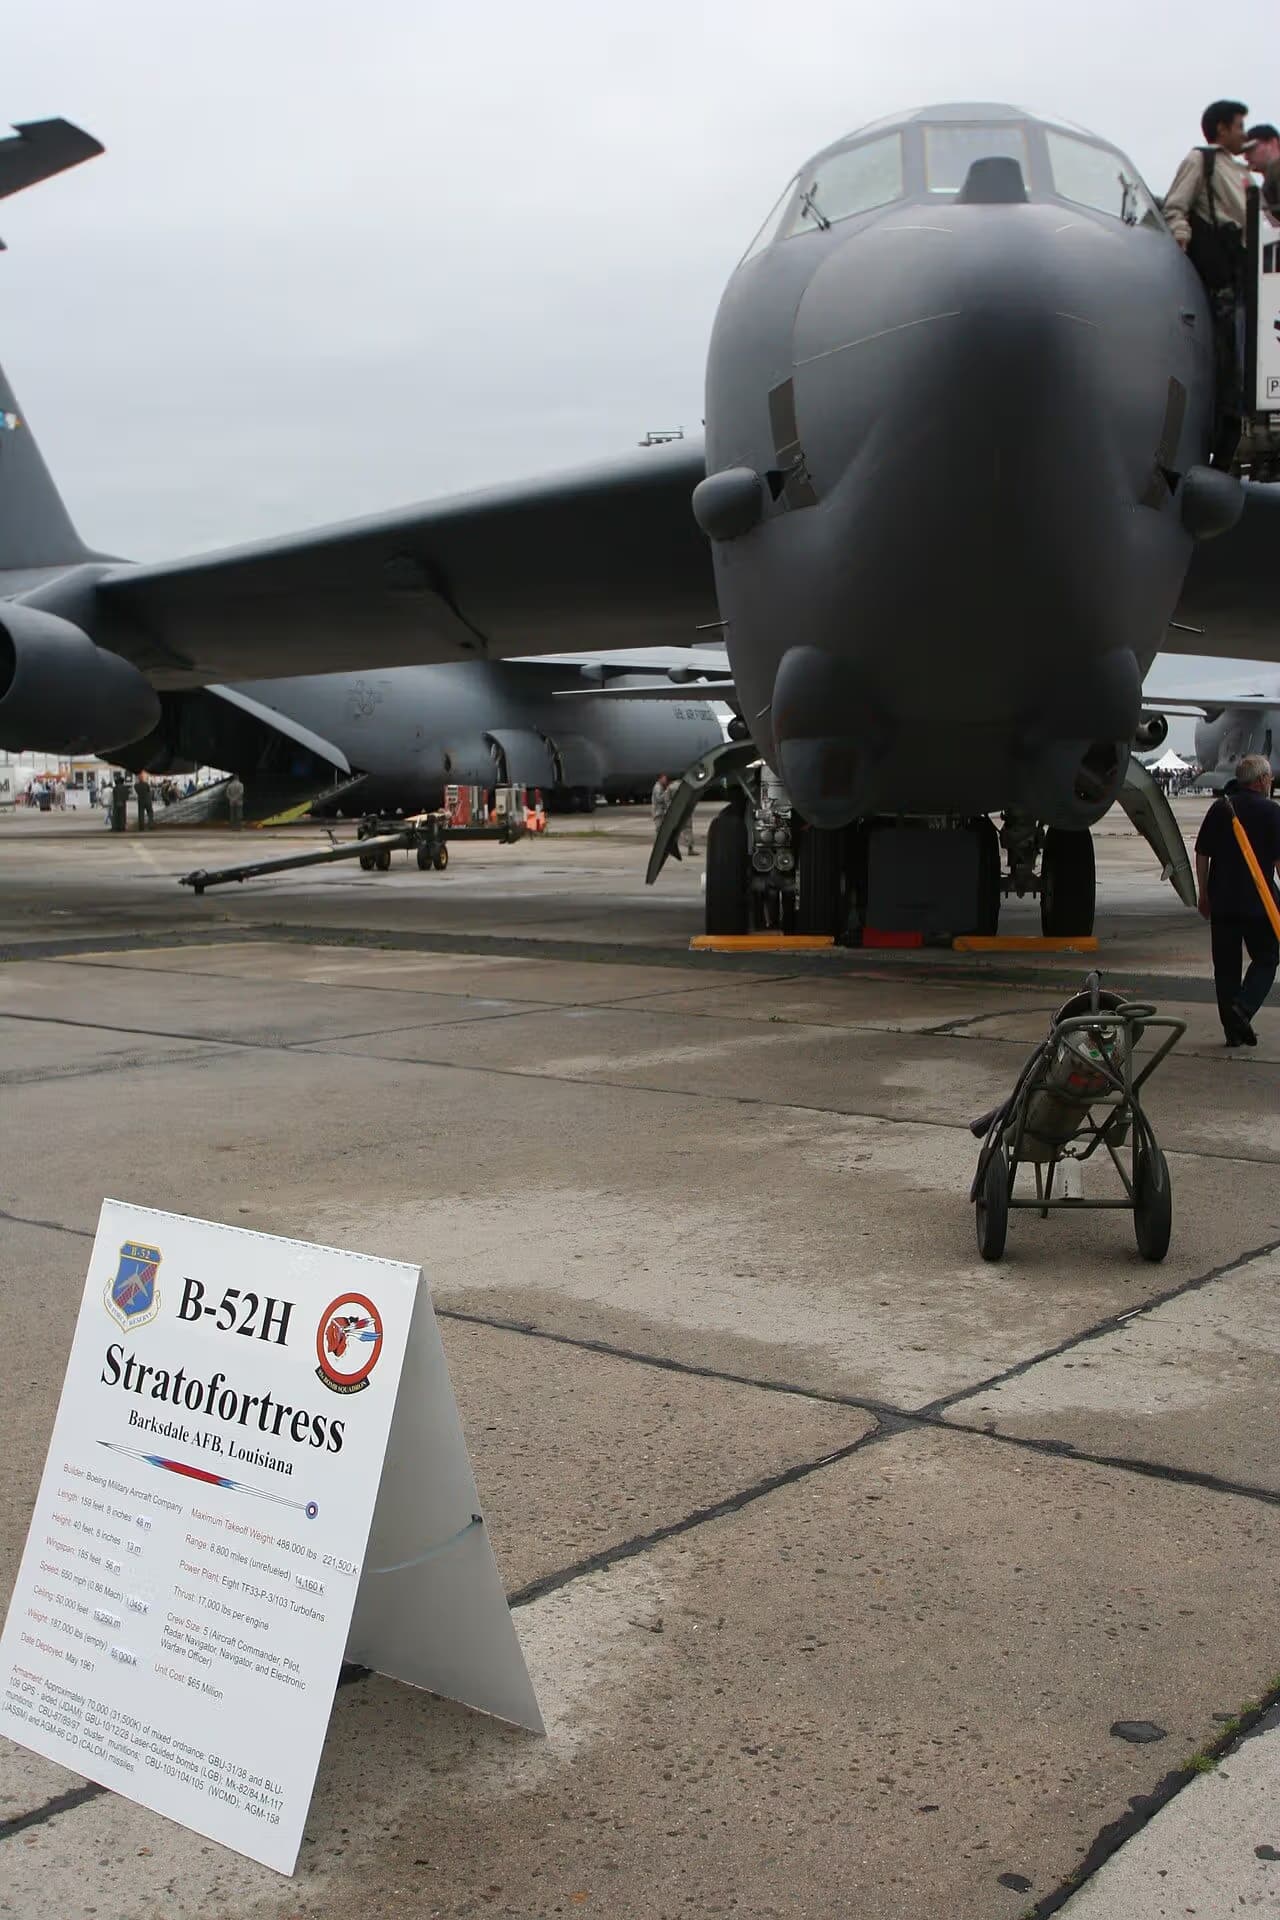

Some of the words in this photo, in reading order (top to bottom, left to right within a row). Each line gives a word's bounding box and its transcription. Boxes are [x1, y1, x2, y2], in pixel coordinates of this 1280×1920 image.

[175, 1276, 295, 1346] B-52H
[99, 1343, 347, 1454] Stratofortress
[126, 1409, 191, 1442] Barksdale
[191, 1429, 227, 1454] AFB,
[227, 1440, 296, 1475] Louisiana
[79, 1496, 92, 1507] 159
[111, 1507, 132, 1522] inches
[85, 1471, 107, 1487] Boeing
[106, 1479, 129, 1495] Military
[129, 1487, 152, 1502] Aircraft
[151, 1495, 183, 1515] Company
[100, 1530, 121, 1545] inches
[190, 1508, 223, 1527] Maximum
[223, 1519, 249, 1535] Takeoff
[305, 1548, 318, 1559] lbs
[321, 1554, 352, 1572] 221,500
[229, 1549, 249, 1564] miles
[249, 1556, 292, 1580] (unrefueled)
[72, 1573, 87, 1587] mph
[103, 1585, 124, 1600] Mach)
[178, 1560, 201, 1575] Power
[220, 1575, 240, 1592] Eight
[239, 1582, 289, 1608] TF33-P-3/103
[288, 1600, 326, 1622] Turbofans
[220, 1603, 232, 1615] lbs
[231, 1610, 244, 1622] per
[244, 1615, 269, 1632] engine
[20, 1632, 35, 1645] Date
[64, 1651, 79, 1666] May
[79, 1657, 95, 1671] 1961
[73, 1627, 84, 1638] lbs
[83, 1632, 108, 1650] (empty)
[159, 1638, 186, 1656] Warfare
[186, 1649, 213, 1667] Officer)
[163, 1625, 185, 1641] Radar
[183, 1633, 219, 1656] Navigator,
[218, 1646, 255, 1671] Navigator,
[254, 1660, 270, 1675] and
[270, 1666, 307, 1690] Electronic
[166, 1611, 185, 1626] Crew
[209, 1628, 237, 1647] (Aircraft
[236, 1639, 283, 1665] Commander,
[153, 1663, 168, 1676] Unit
[186, 1676, 201, 1689] $65
[200, 1682, 224, 1699] Million
[20, 1682, 35, 1695] GPS
[130, 1733, 175, 1760] Laser-Guided
[175, 1754, 200, 1772] bombs
[28, 1714, 40, 1726] and
[142, 1724, 151, 1734] of
[150, 1728, 171, 1744] mixed
[248, 1772, 263, 1786] and
[264, 1779, 284, 1795] BLU-
[244, 1800, 280, 1825] AGM-158
